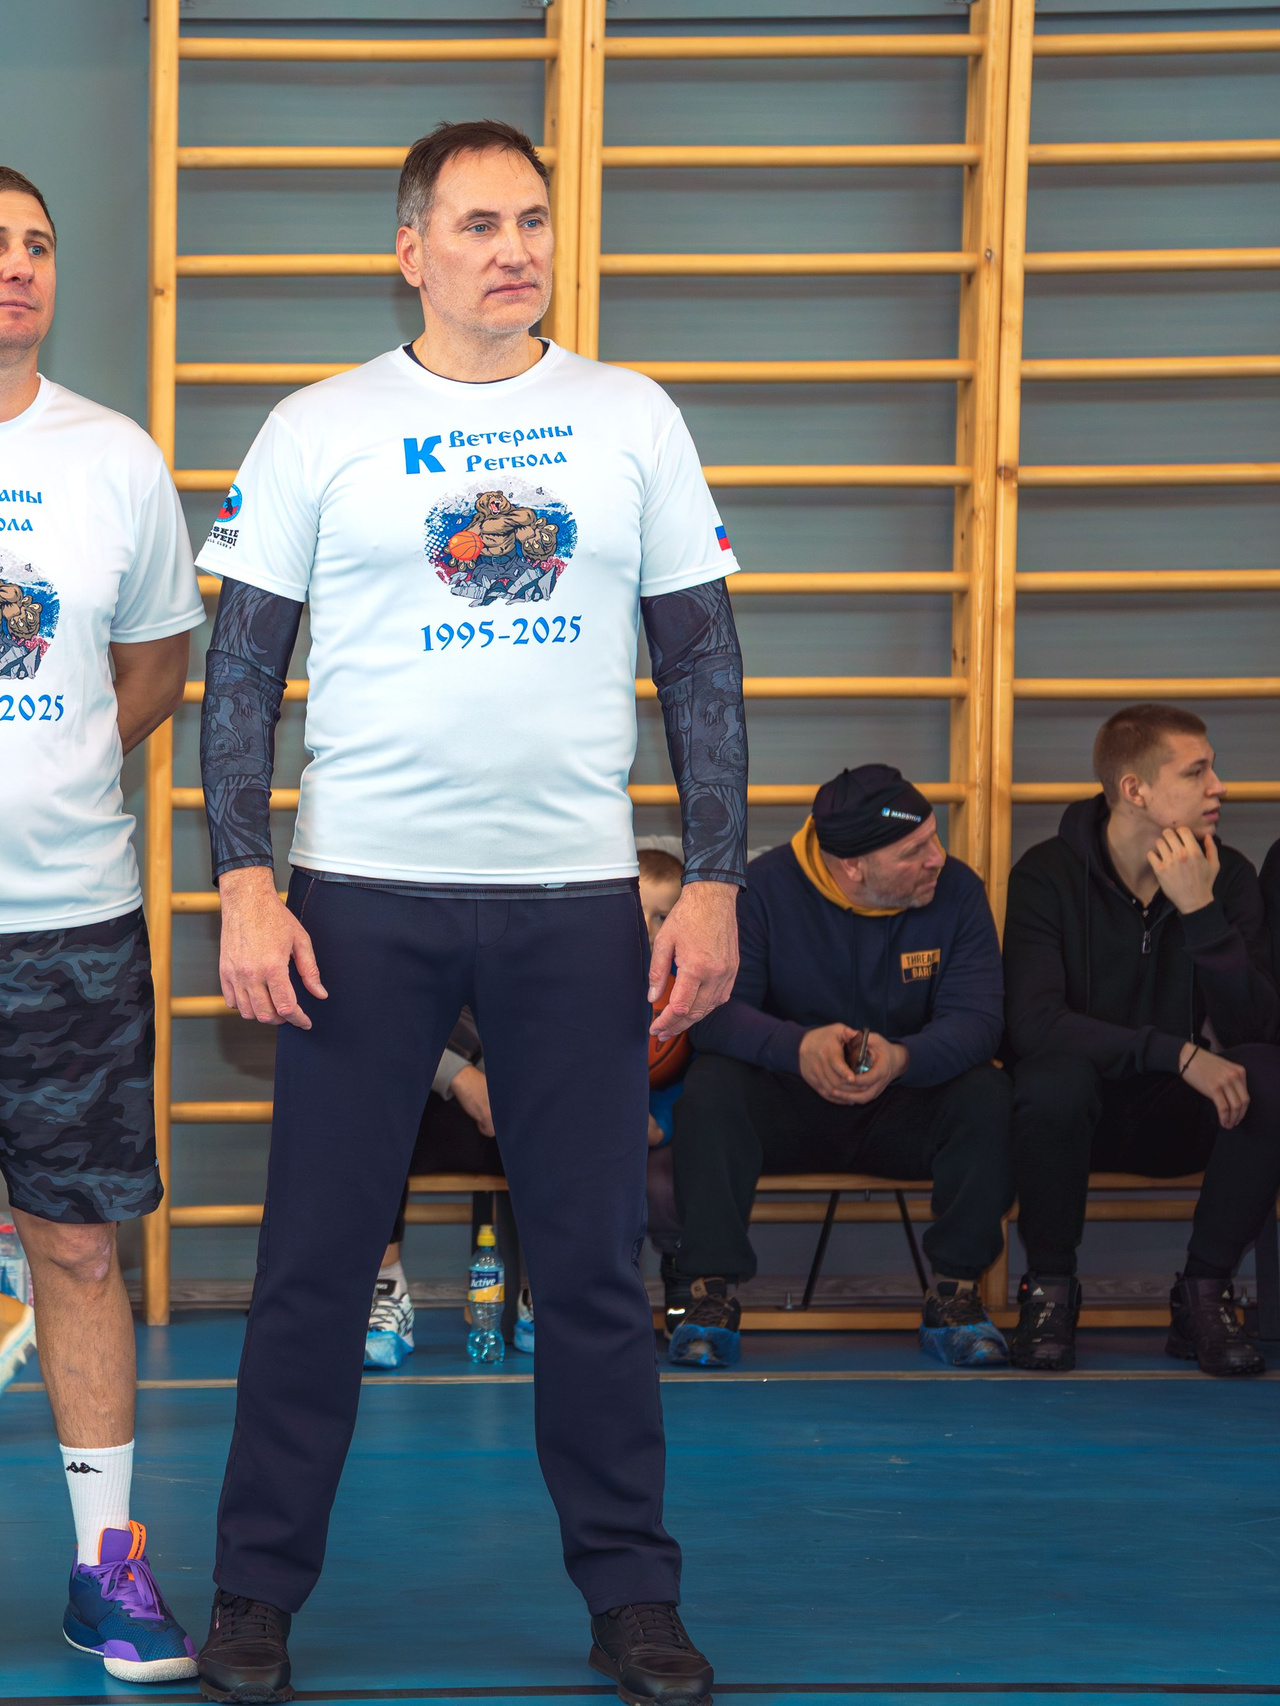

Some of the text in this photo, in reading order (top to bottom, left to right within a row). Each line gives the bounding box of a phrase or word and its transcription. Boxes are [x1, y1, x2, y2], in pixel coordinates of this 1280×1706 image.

[449, 424, 574, 448] Ветераны
[403, 435, 446, 475] К
[420, 615, 583, 652] 1995-2025
